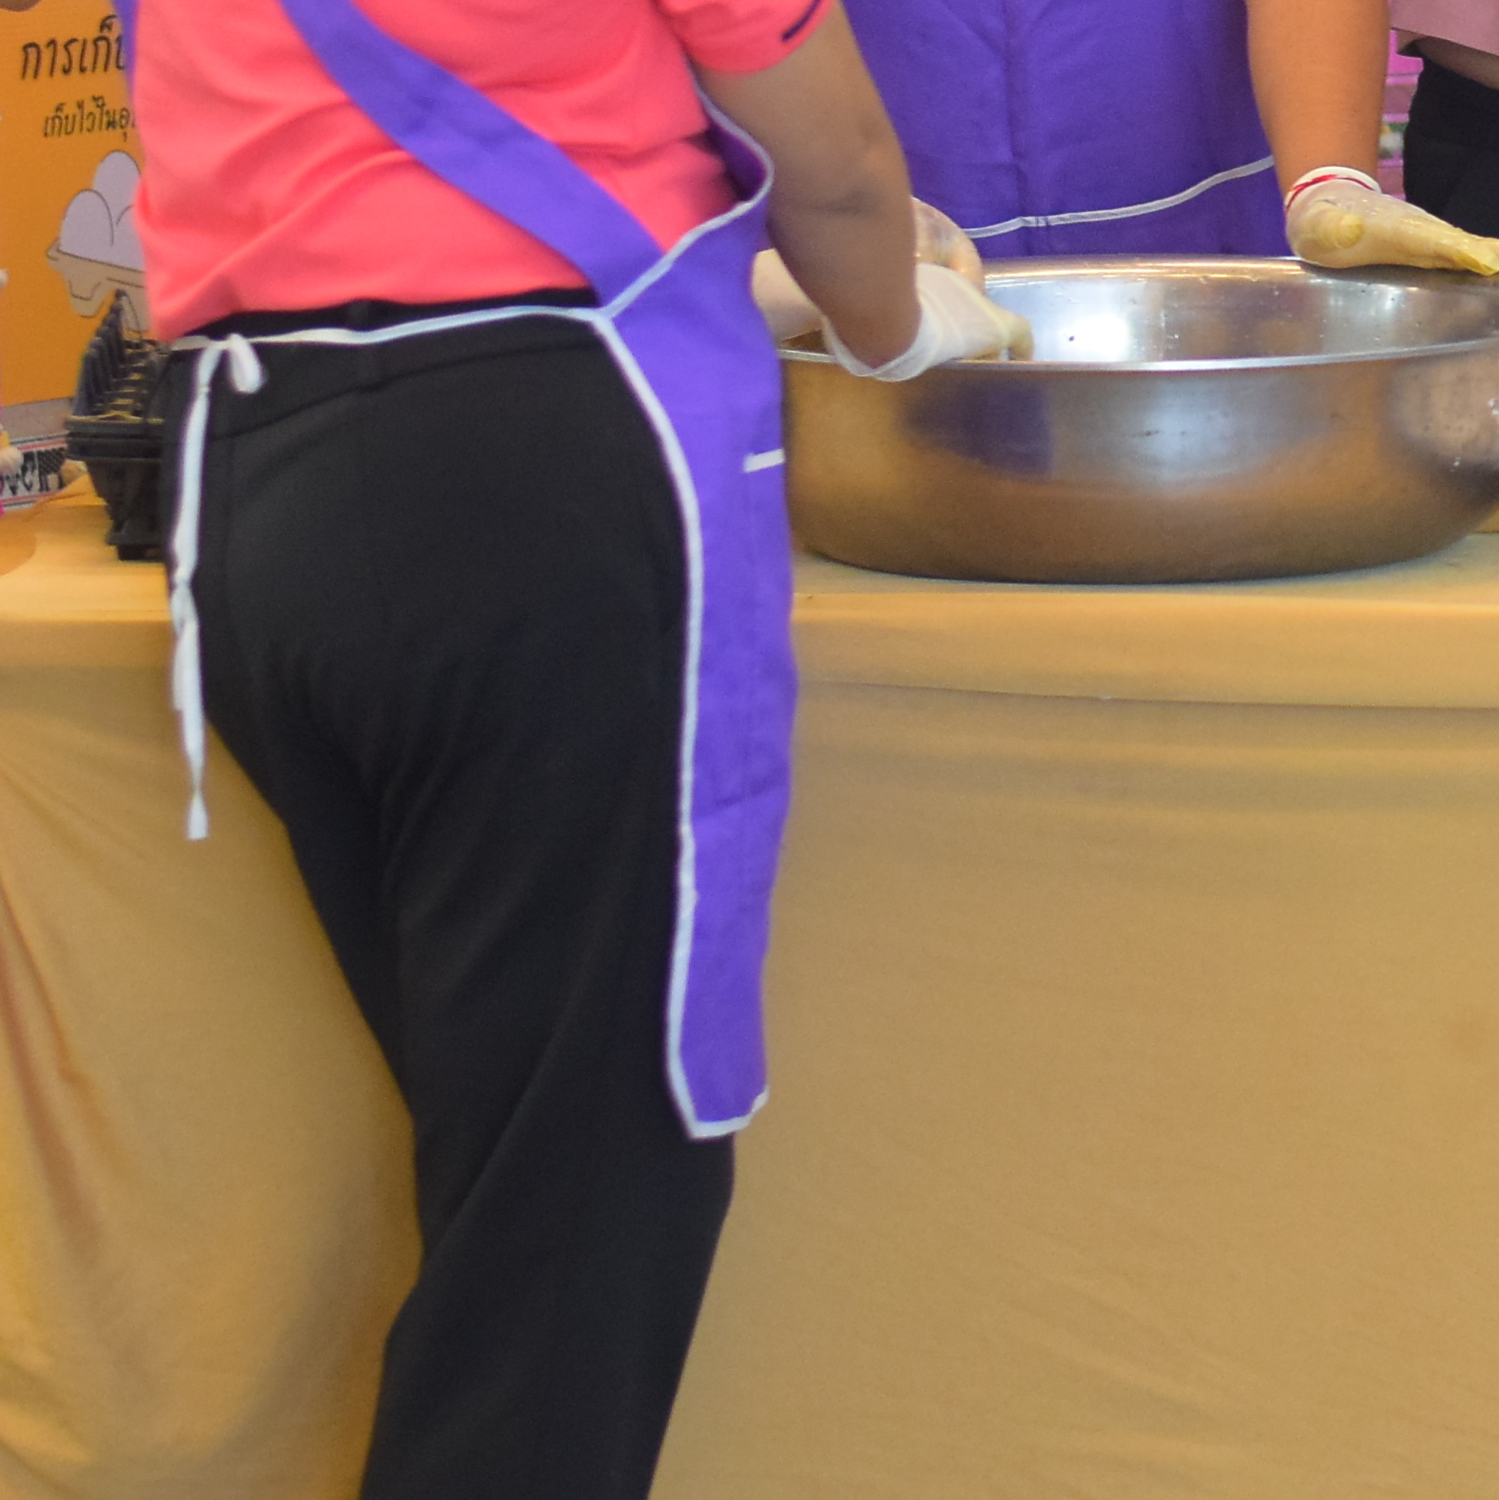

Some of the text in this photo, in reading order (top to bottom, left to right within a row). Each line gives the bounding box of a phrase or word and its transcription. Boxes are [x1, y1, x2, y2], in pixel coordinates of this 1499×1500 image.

[44, 95, 136, 143] เก็บไว้ในอุ
